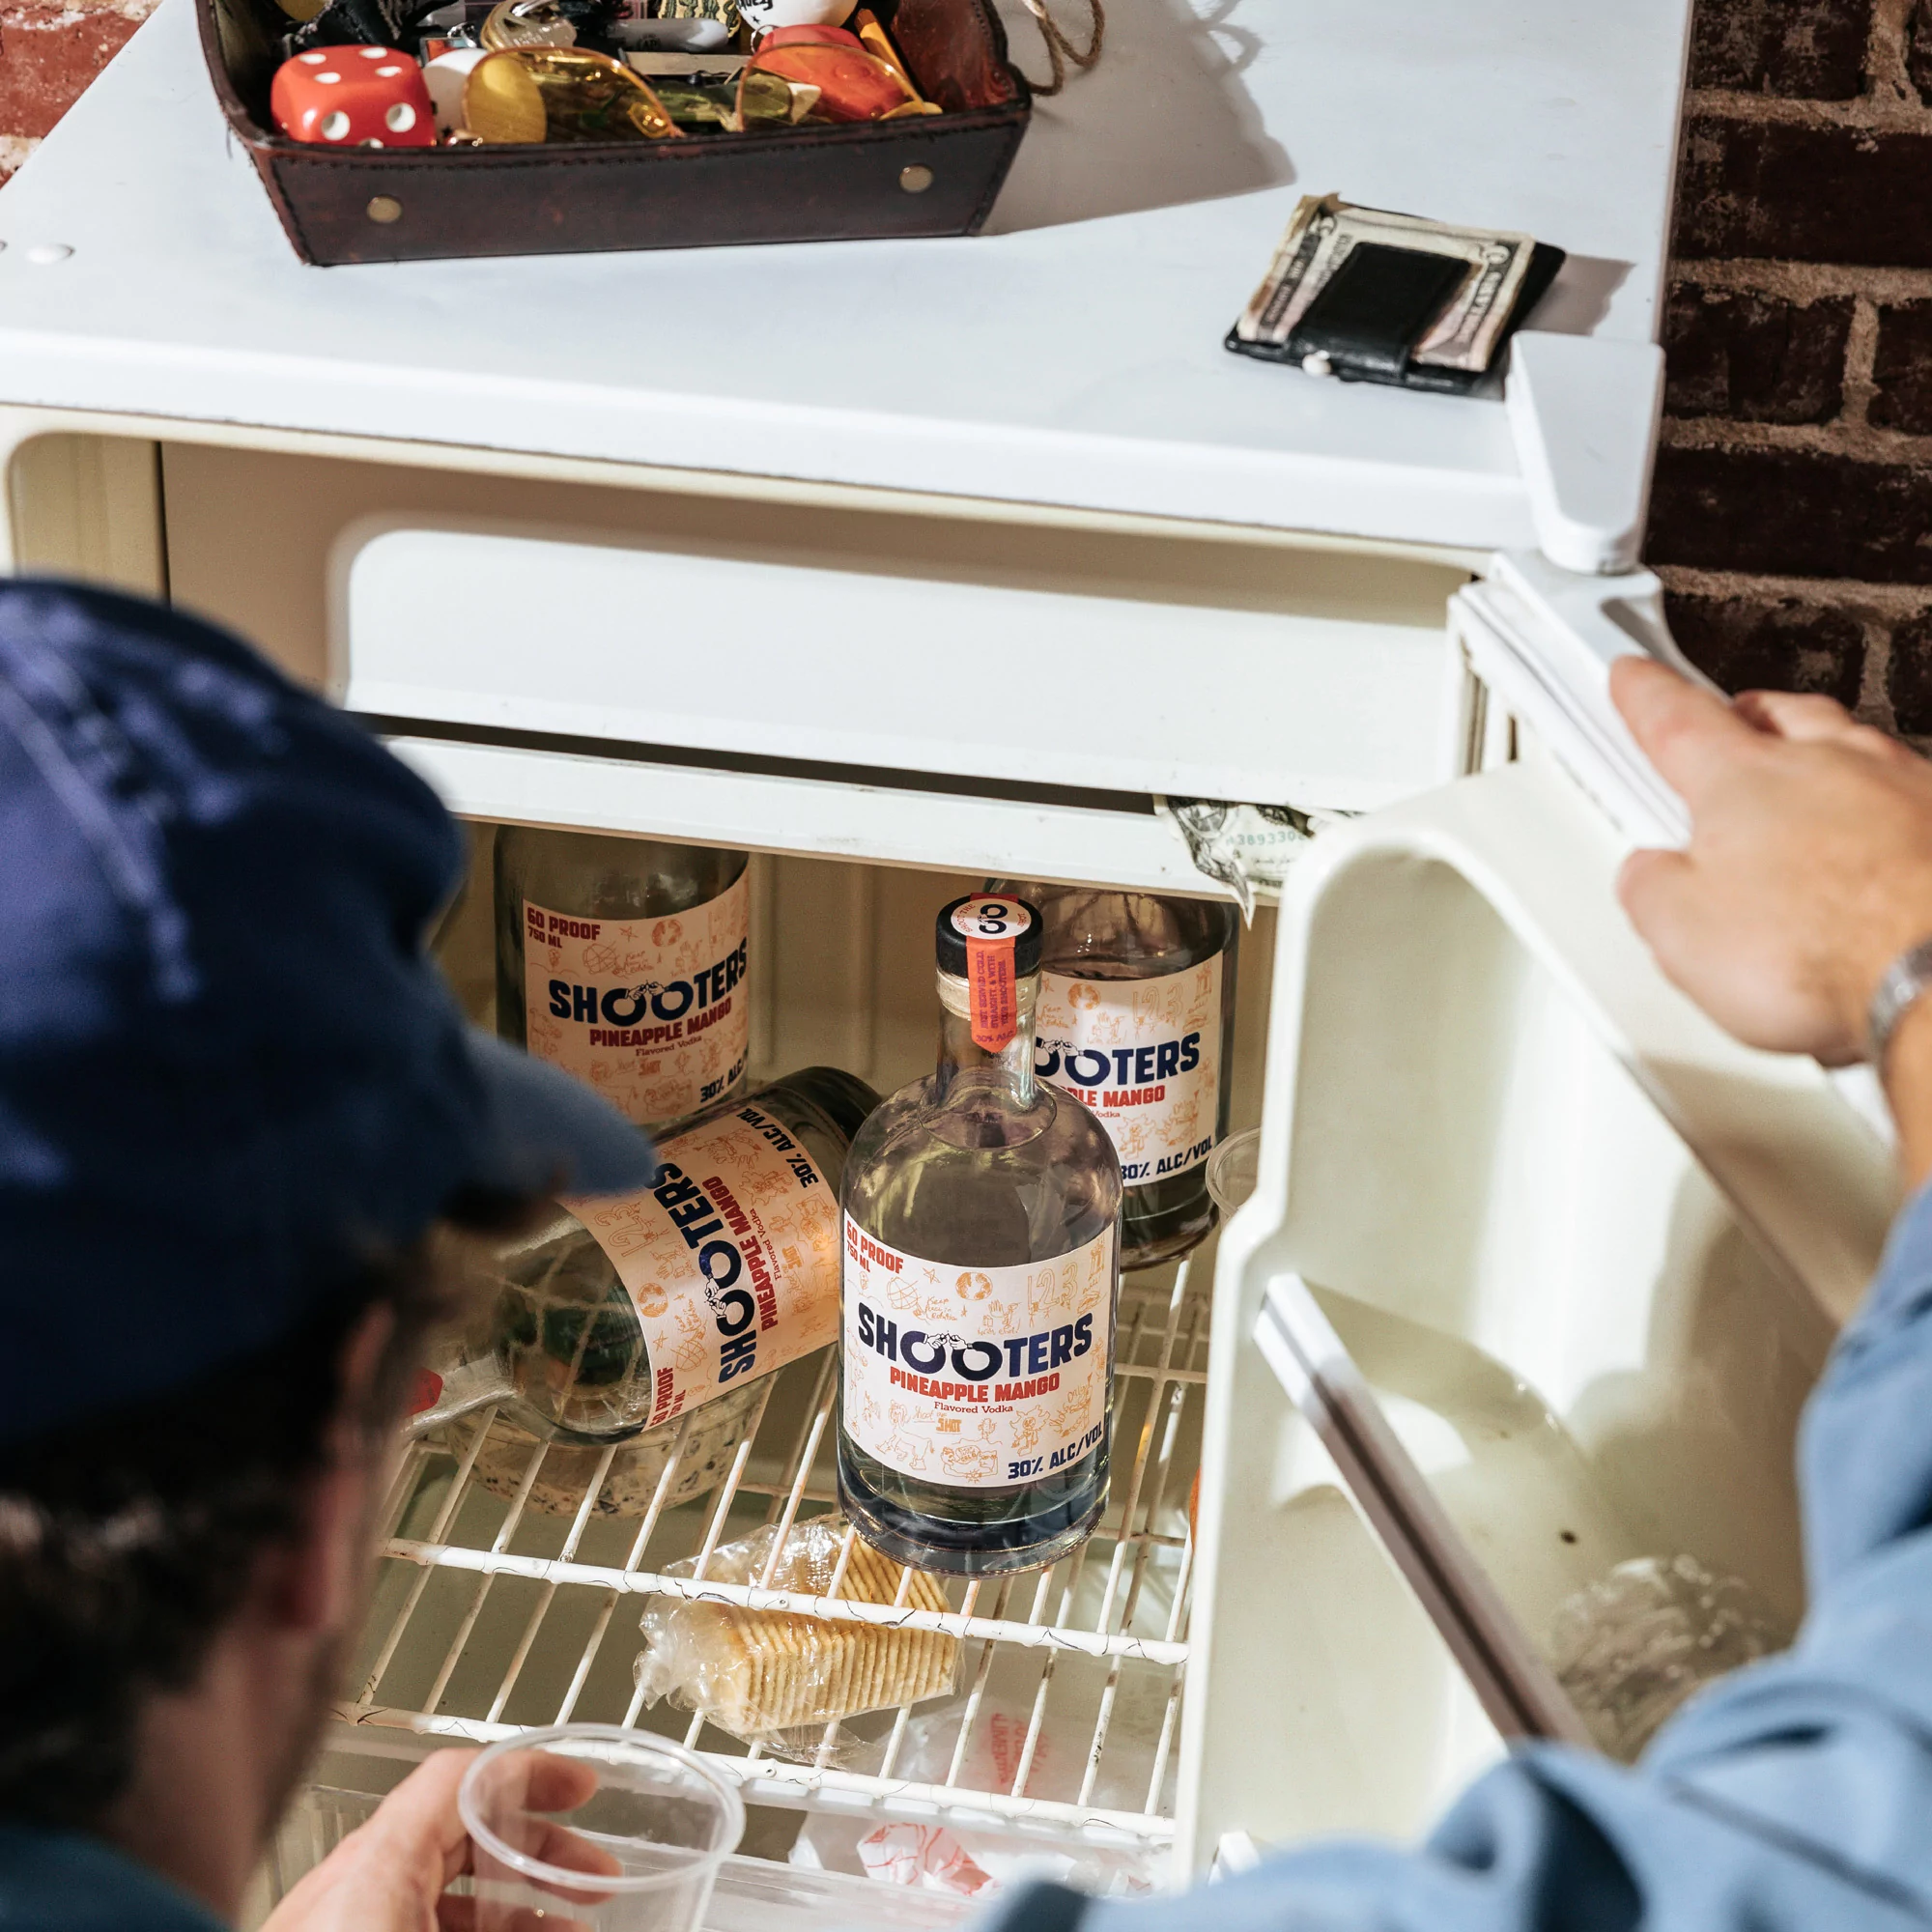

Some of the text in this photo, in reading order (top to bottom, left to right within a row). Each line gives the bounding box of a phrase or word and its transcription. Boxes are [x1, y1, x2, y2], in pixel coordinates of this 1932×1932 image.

[527, 907, 601, 941] 60 PROOF
[528, 925, 562, 949] 750 ML
[956, 903, 976, 933] SHOOT THE
[549, 937, 748, 1027] SHOOTERS
[987, 955, 996, 979] WITH
[589, 998, 732, 1047] PINEAPPLE MANGO
[636, 1035, 702, 1057] Flavored Vodka
[1035, 1032, 1201, 1087] OOTERS
[700, 1076, 724, 1103] 30%
[1103, 1085, 1165, 1108] MANGO
[736, 1108, 819, 1188] 30% ALC/VOL
[1156, 1135, 1212, 1175] ALC/VOL
[702, 1176, 752, 1236] MANGO
[750, 1208, 782, 1281] Flavored Vodka
[847, 1220, 904, 1274] 60 PROOF
[847, 1240, 870, 1273] 750 ML
[644, 1163, 757, 1383] SHOOTERS
[739, 1236, 779, 1332] PINEAPPLE
[858, 1301, 1094, 1381] SHOOTERS
[649, 1367, 674, 1428] 60 PROOF
[674, 1389, 687, 1402] ML
[890, 1366, 1060, 1403] PINEAPPLE MANGO
[934, 1402, 1013, 1414] Flavored Vodka
[1008, 1420, 1102, 1479] 30% ALC/VOL
